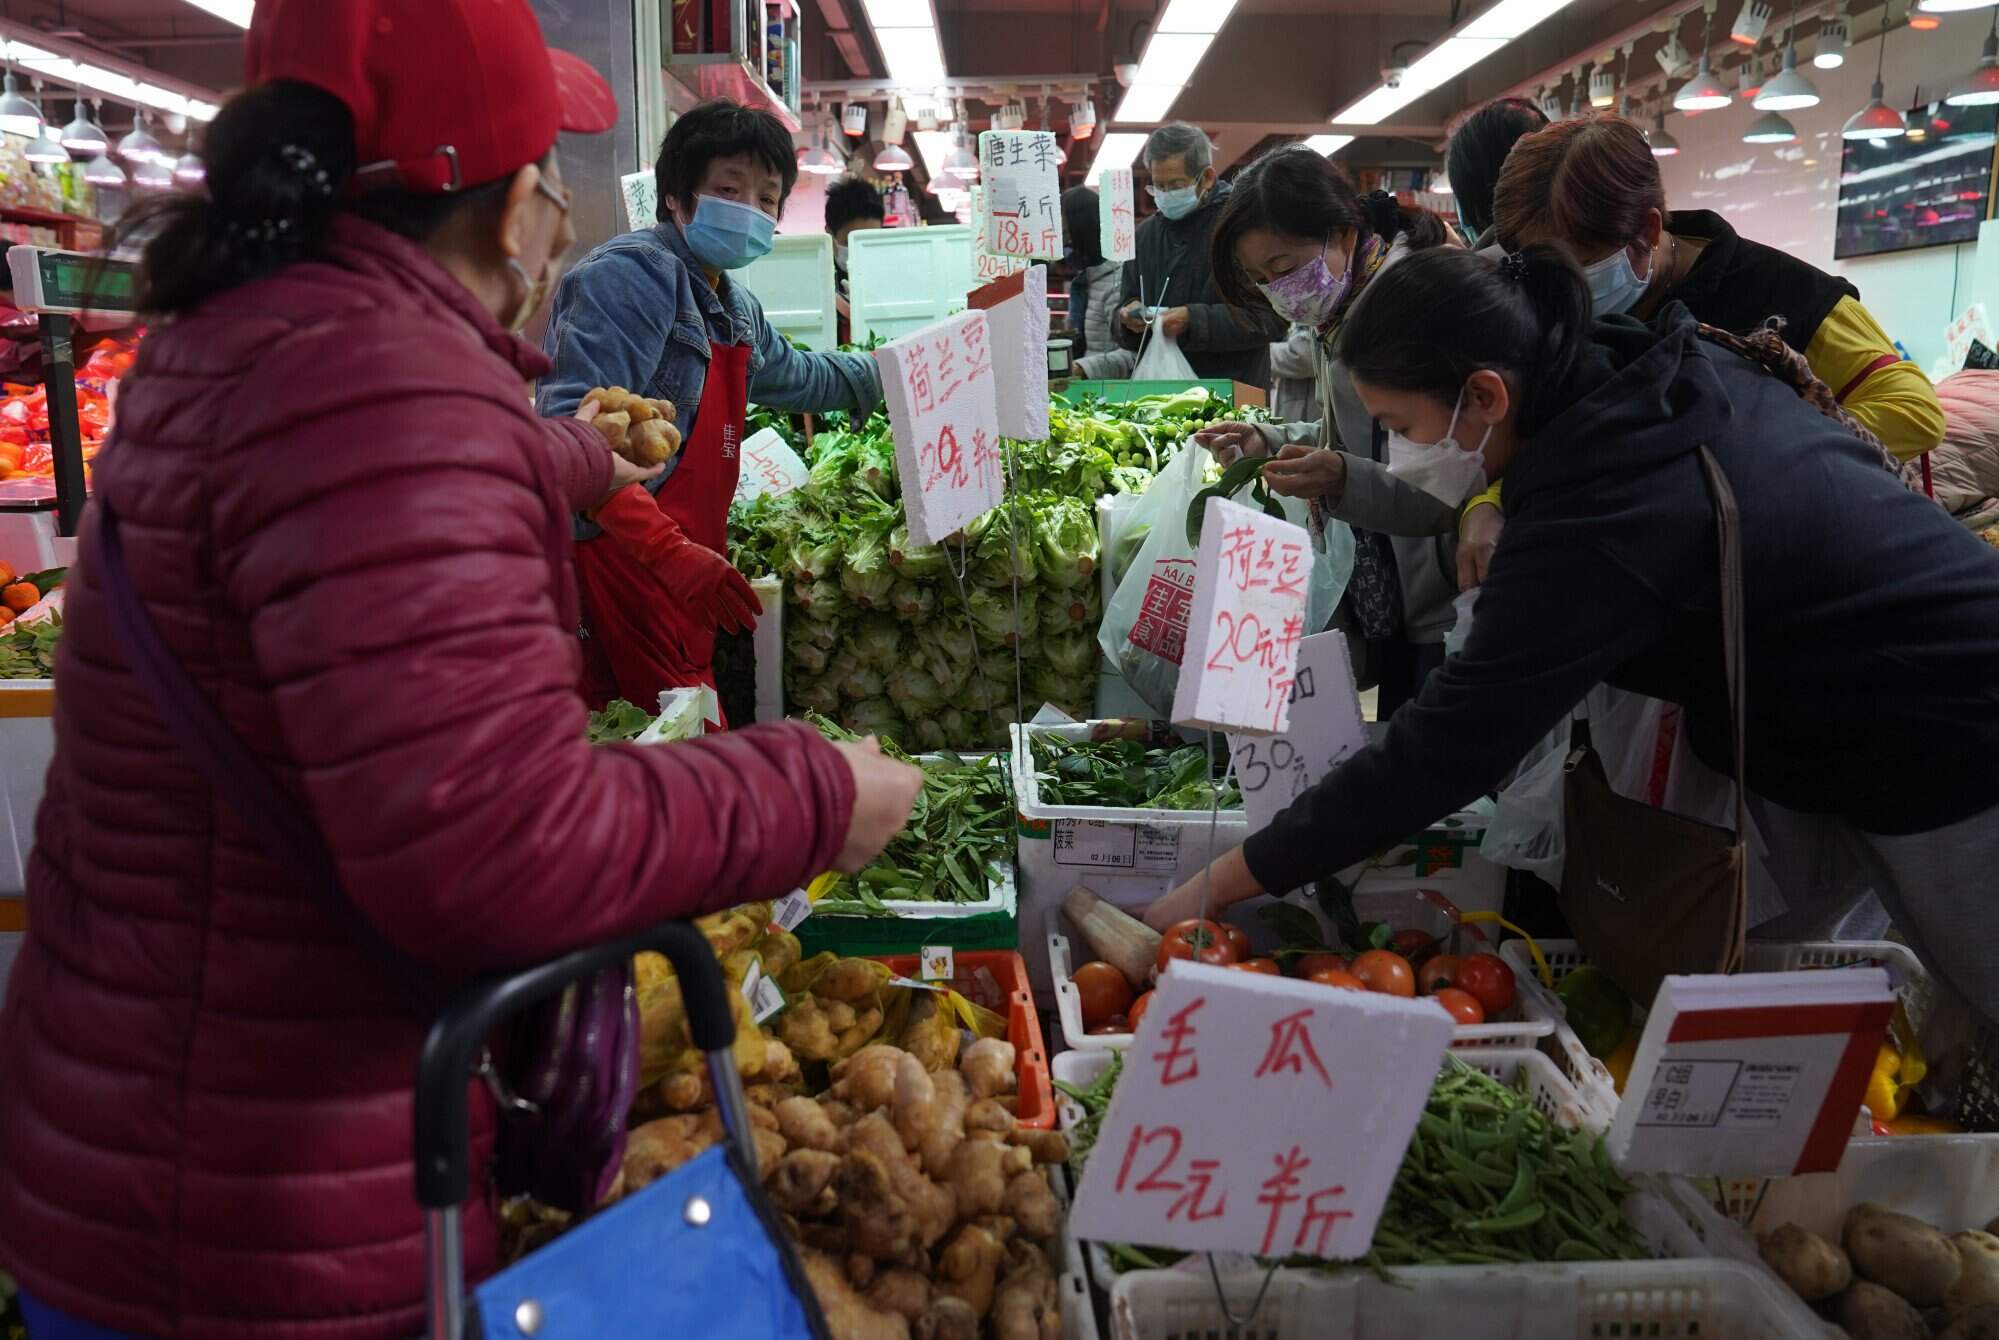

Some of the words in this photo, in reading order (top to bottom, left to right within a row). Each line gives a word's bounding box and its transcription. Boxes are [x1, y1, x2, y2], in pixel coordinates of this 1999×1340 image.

[987, 134, 1057, 171] 唐生菜
[905, 316, 992, 417] 荷兰豆
[1162, 566, 1184, 583] KAI
[1221, 524, 1304, 597] 荷兰豆
